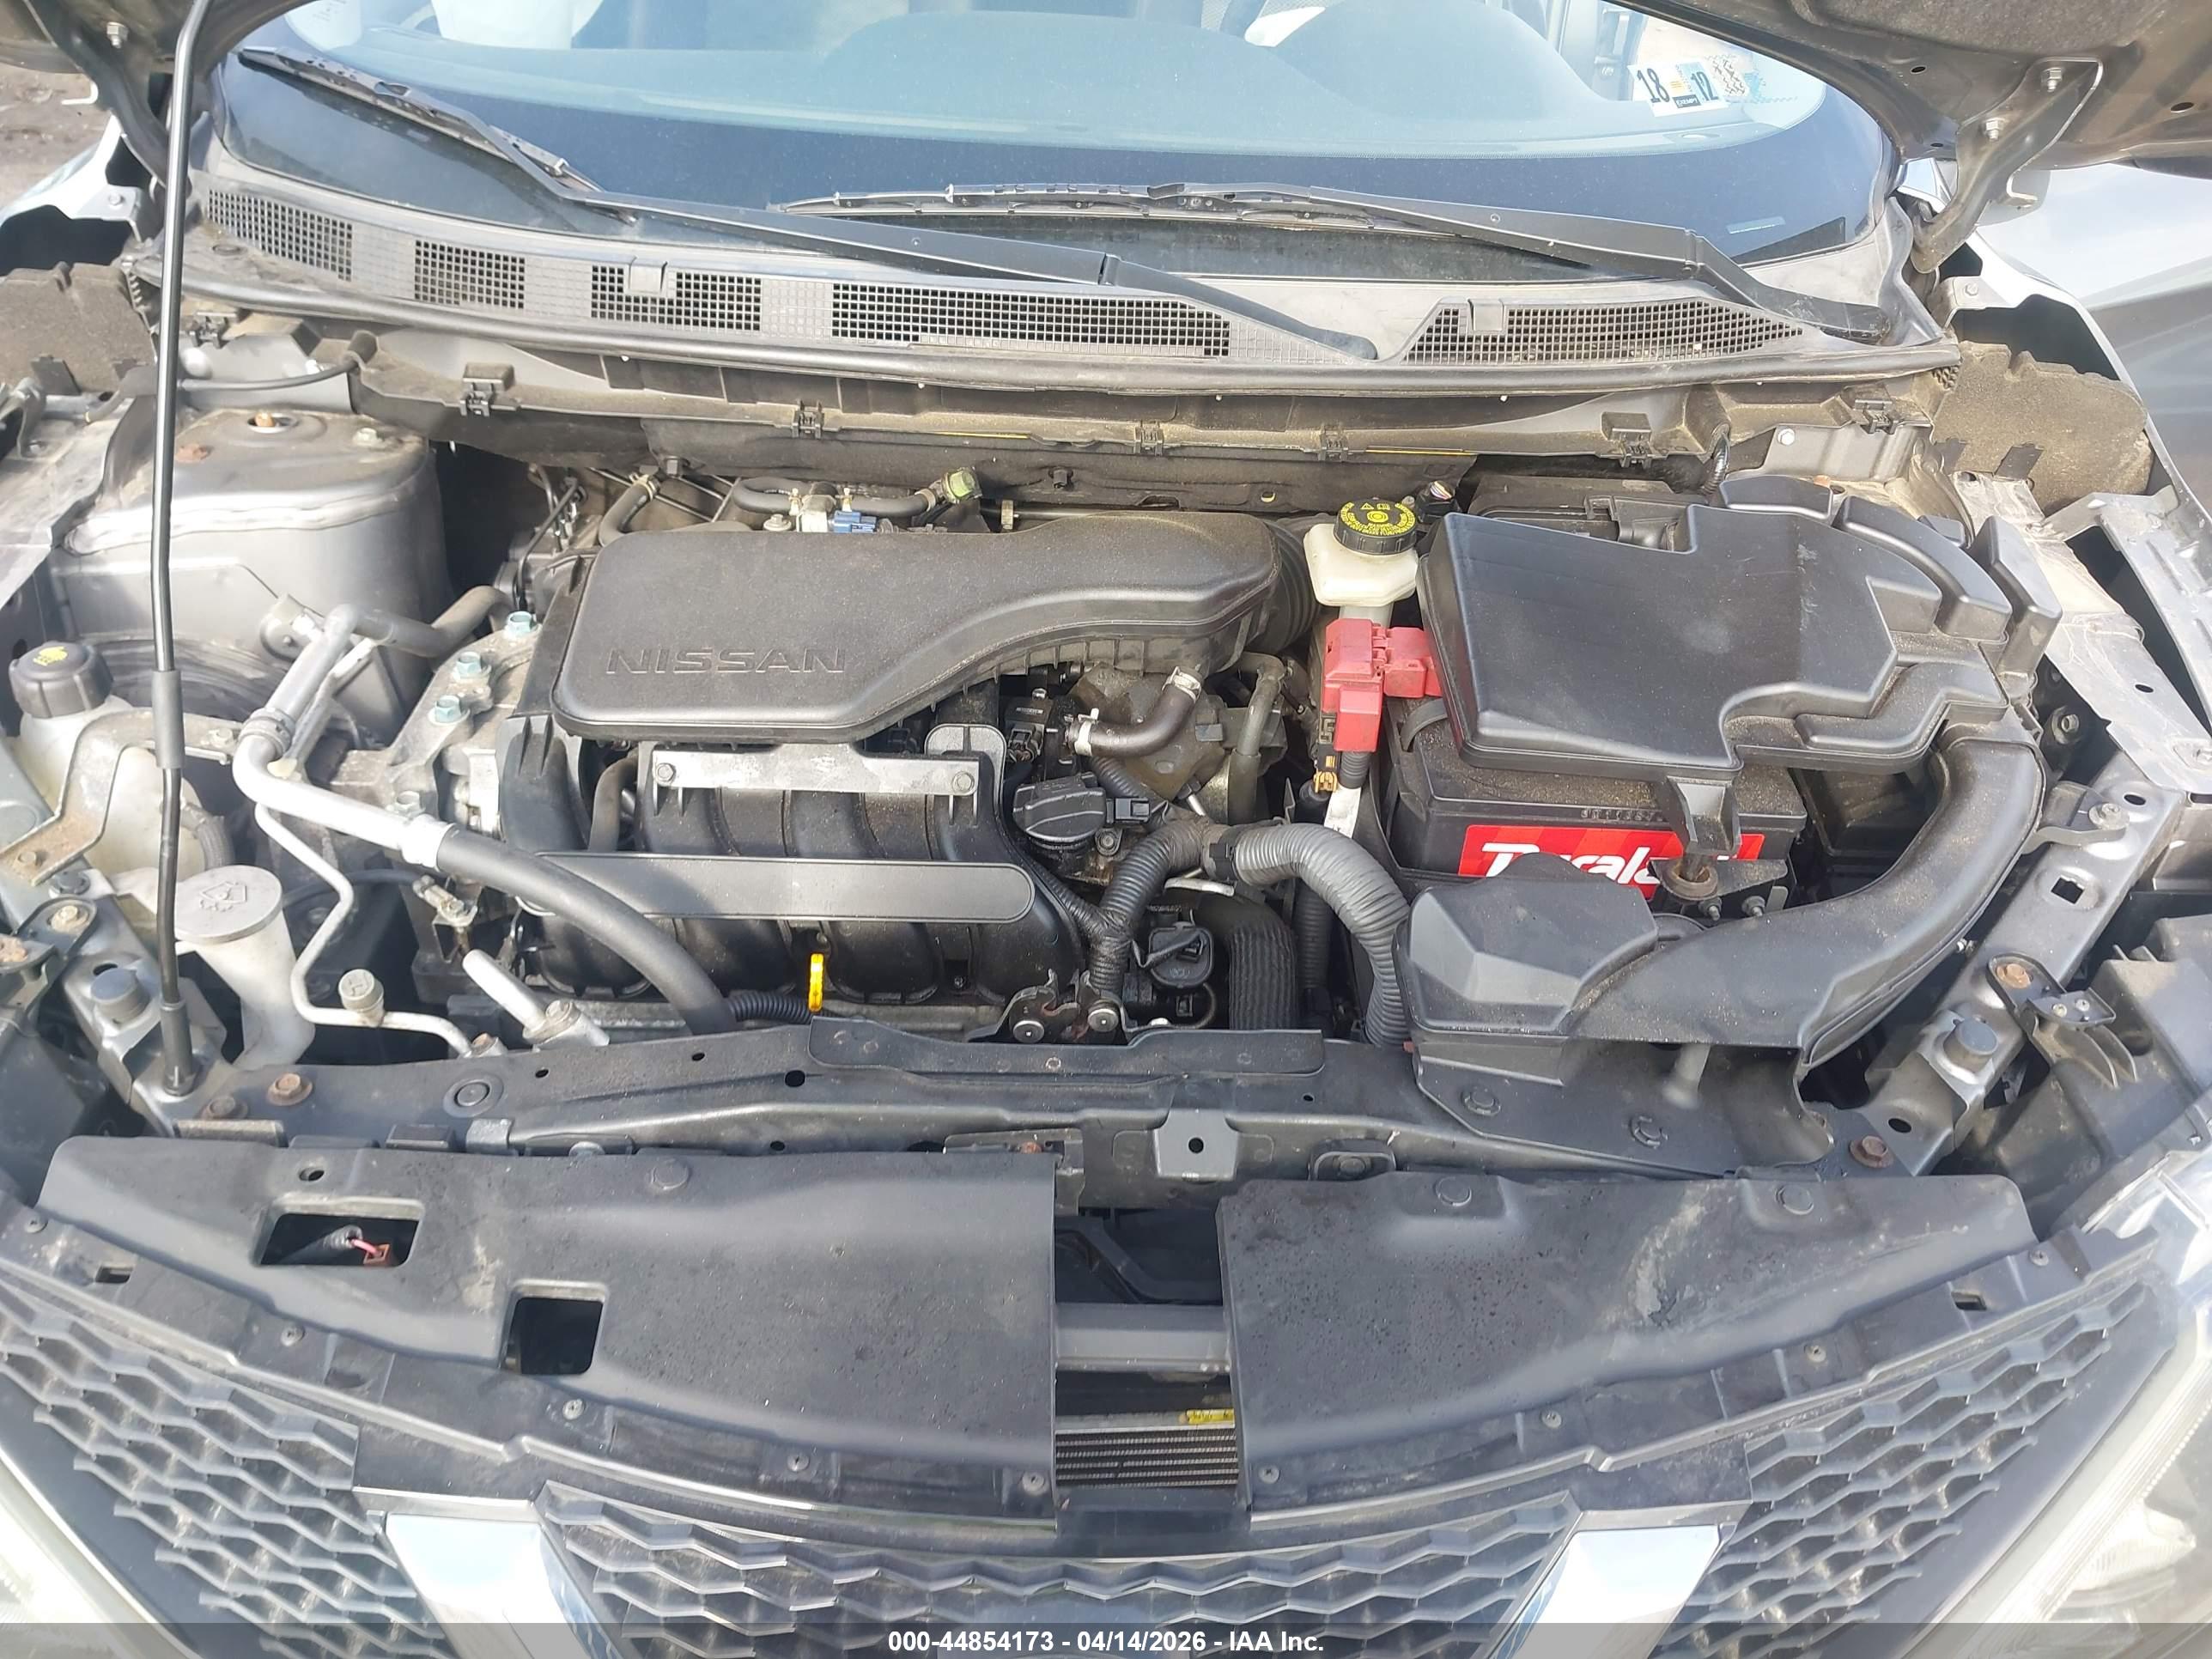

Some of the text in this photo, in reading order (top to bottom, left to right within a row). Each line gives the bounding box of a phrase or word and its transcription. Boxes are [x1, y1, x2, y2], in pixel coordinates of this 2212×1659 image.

[1637, 68, 1670, 103] 18
[1691, 71, 1719, 101] 12
[606, 647, 845, 673] NISSAN
